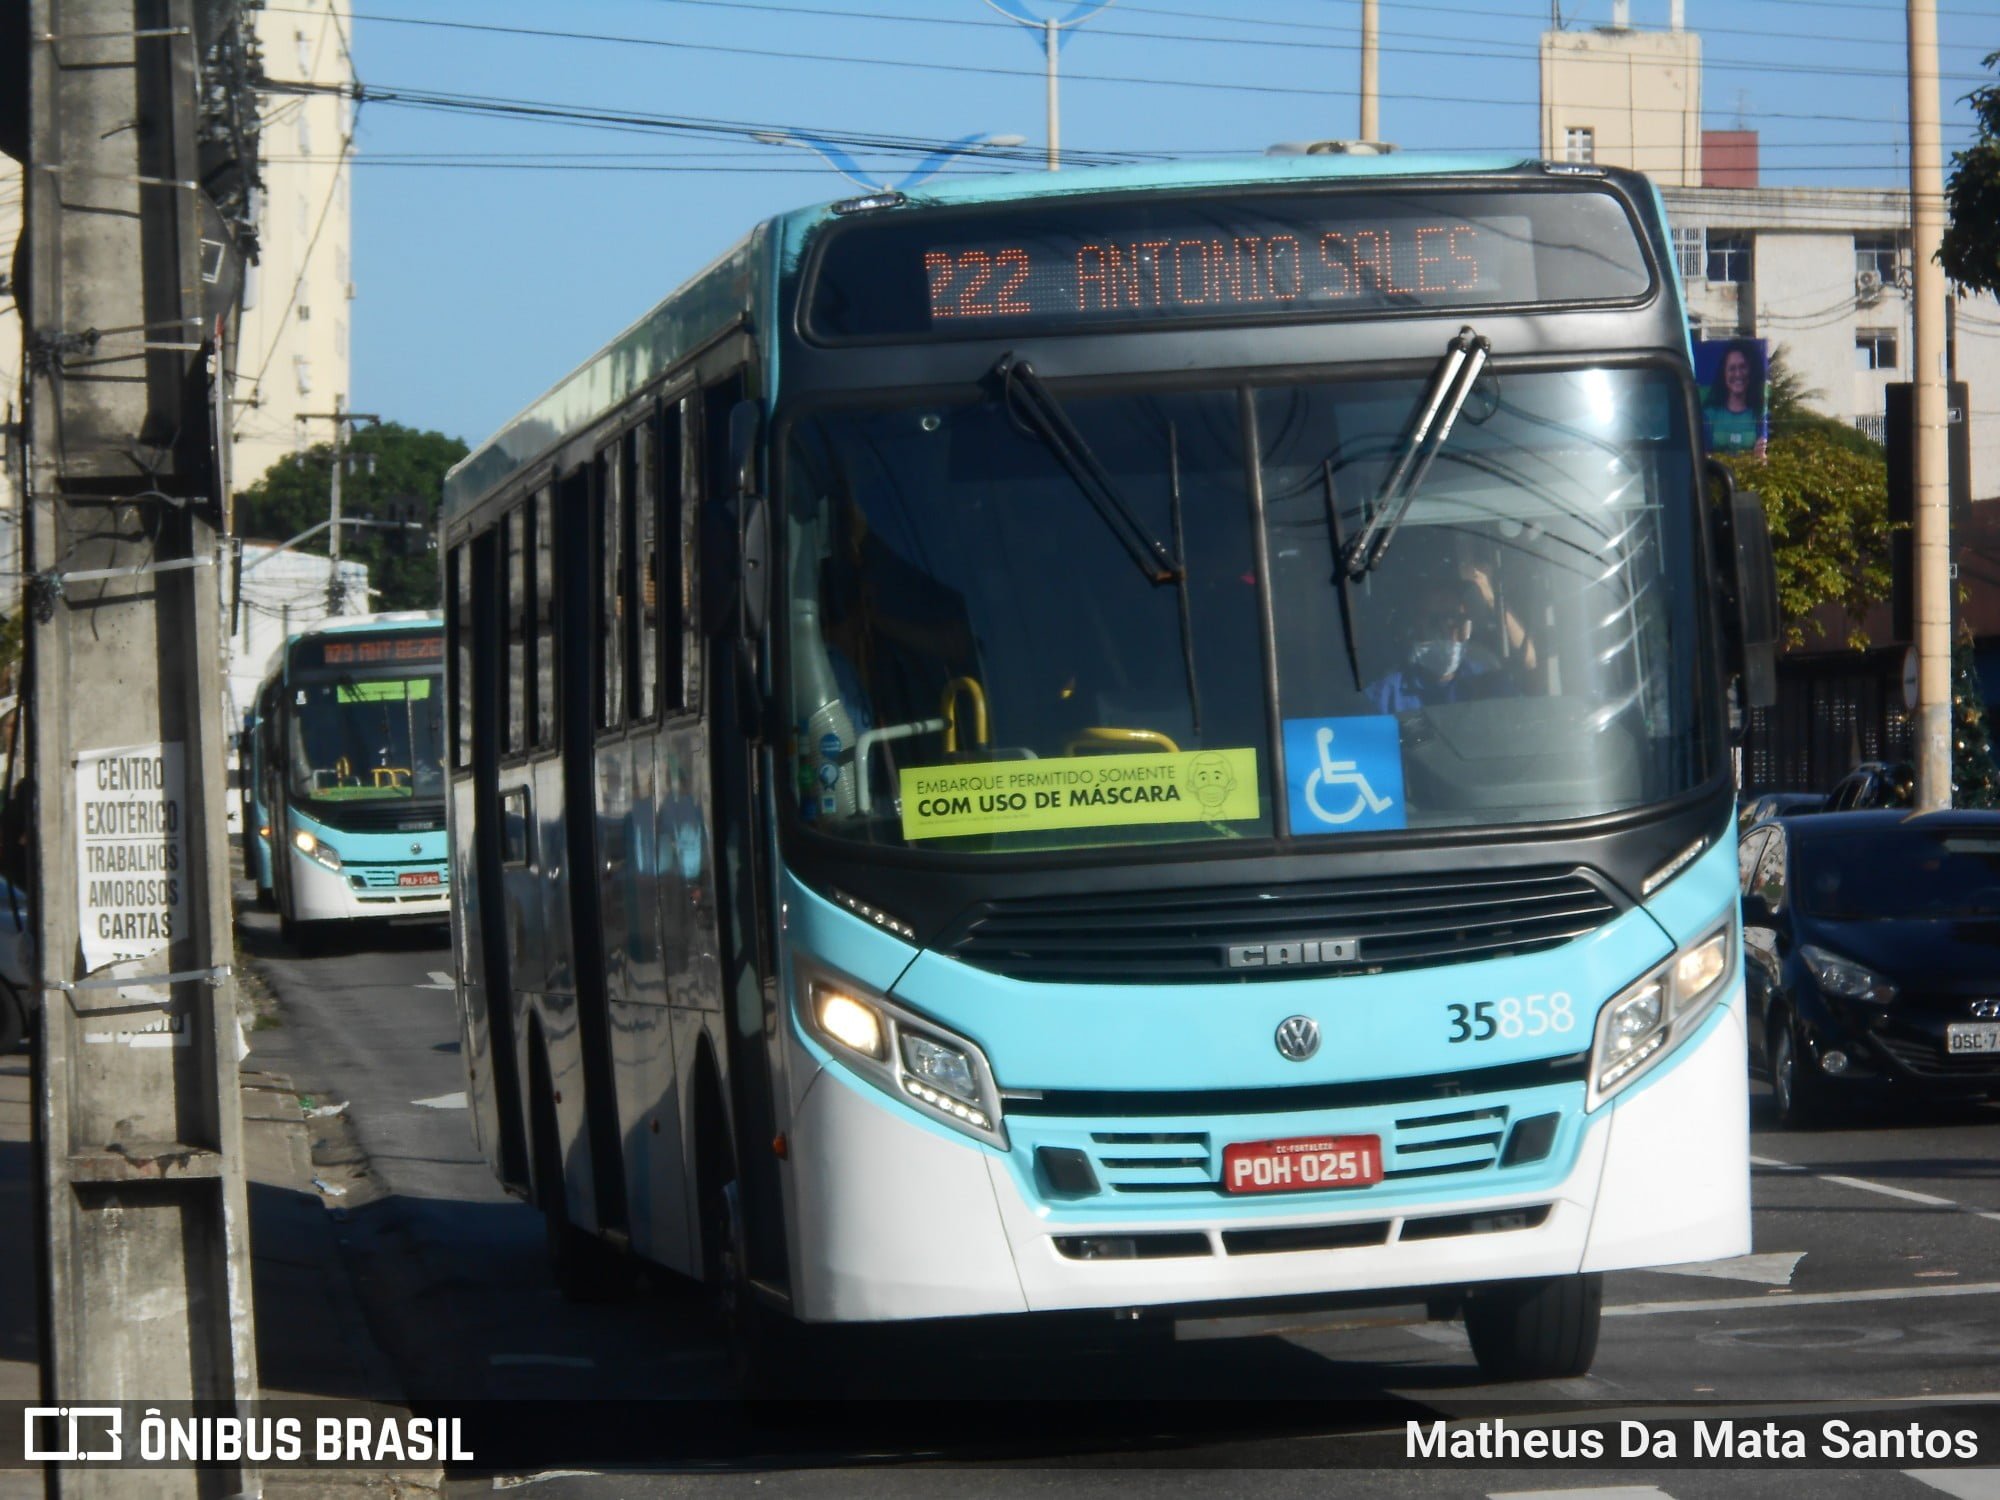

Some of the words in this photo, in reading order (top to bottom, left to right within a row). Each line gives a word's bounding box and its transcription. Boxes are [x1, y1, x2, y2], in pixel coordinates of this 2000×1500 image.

[1077, 235, 1300, 311] ANTONIO
[1320, 225, 1478, 298] SALES
[96, 757, 165, 791] CENTRO
[916, 775, 1005, 795] EMBARQUE
[1009, 769, 1094, 788] PERMITIDO
[1099, 764, 1176, 783] SOMENTE
[85, 793, 178, 835] EXOTÉRICO
[918, 796, 972, 817] COM
[978, 792, 1028, 813] USO
[1034, 790, 1061, 809] DE
[1069, 783, 1181, 807] MÁSCARA
[86, 843, 179, 873] TRABALHOS
[88, 879, 179, 908] AMOROSOS
[98, 911, 173, 940] CARTAS
[1447, 991, 1575, 1043] 35858
[1233, 1150, 1372, 1187] POH-0251
